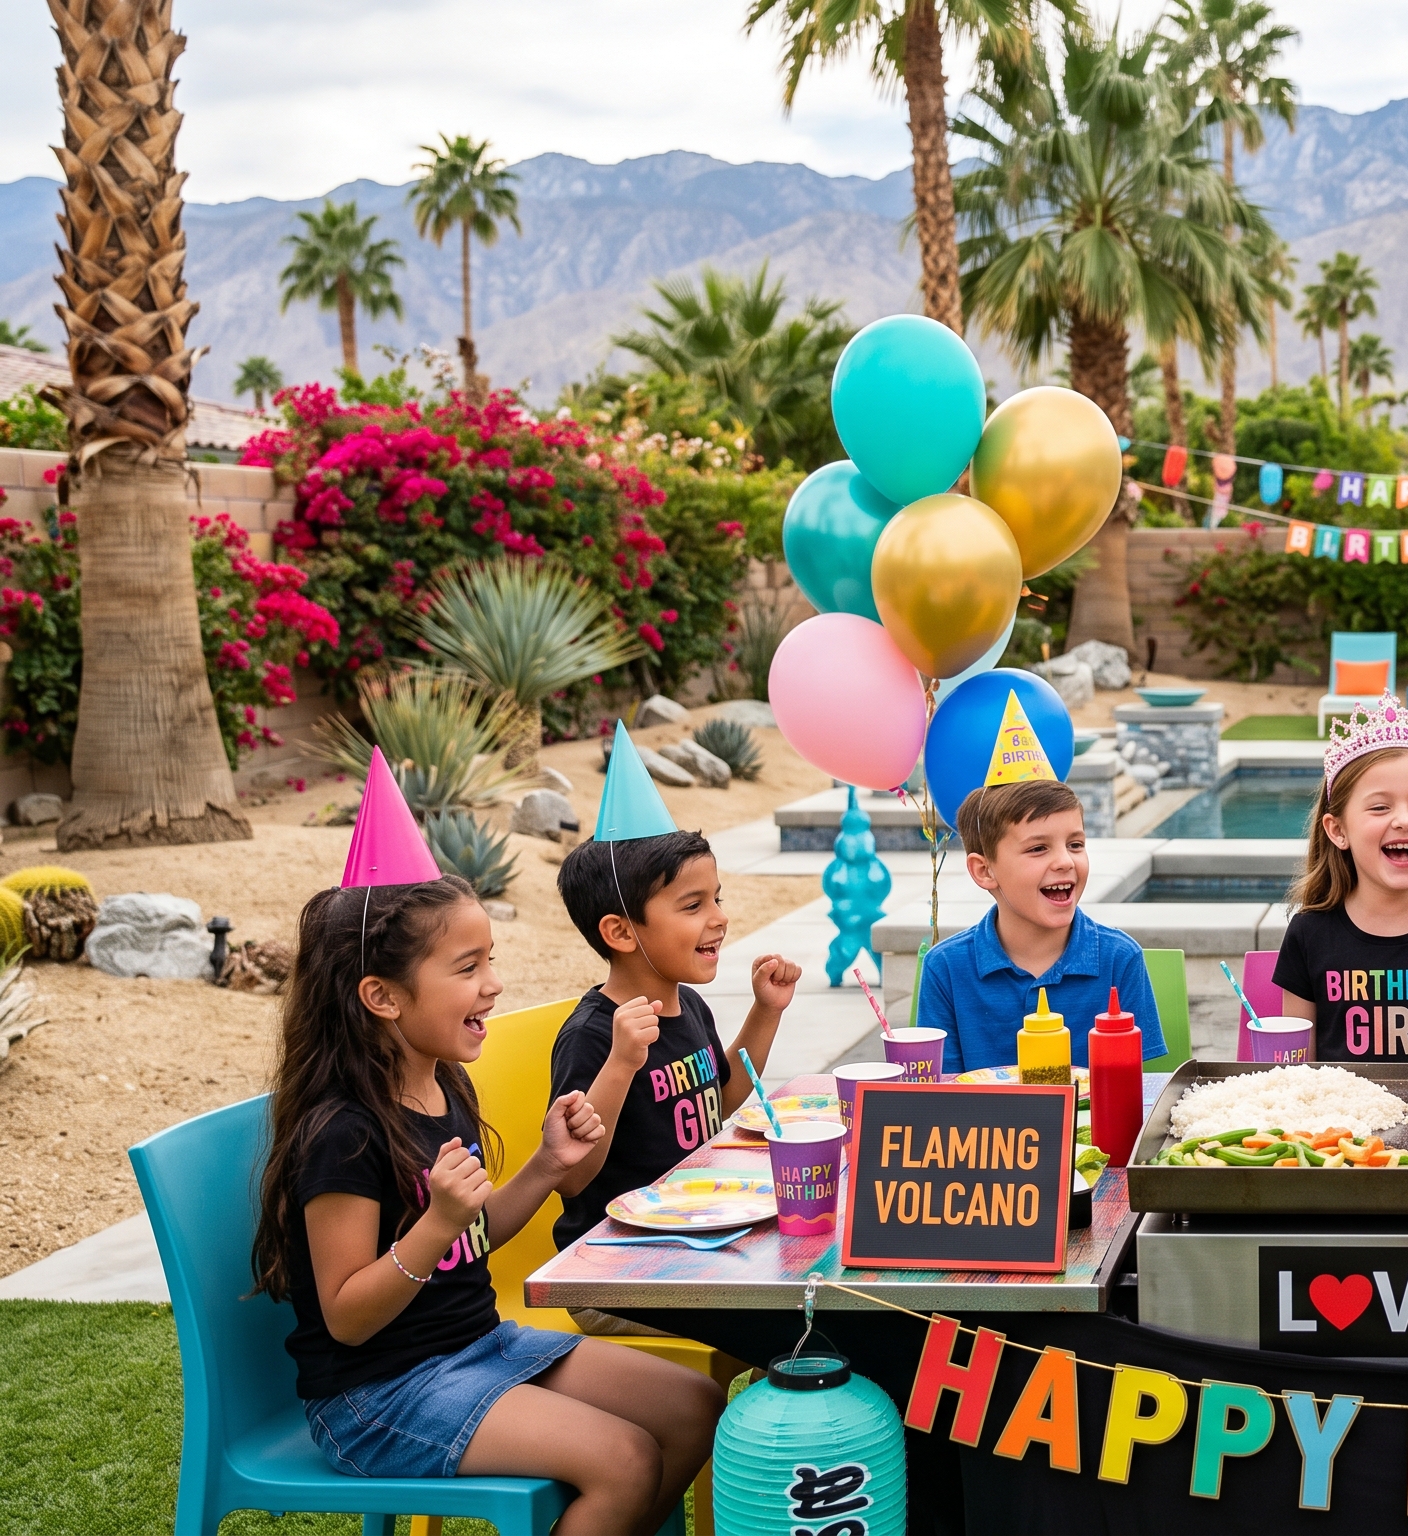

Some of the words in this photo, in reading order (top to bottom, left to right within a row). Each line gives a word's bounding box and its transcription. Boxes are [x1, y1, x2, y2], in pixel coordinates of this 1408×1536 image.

[880, 1125, 1040, 1170] FLAMING
[781, 1163, 832, 1183] HAPPY
[874, 1180, 1040, 1227] VOLCANO
[902, 1312, 1364, 1512] HAPPY
